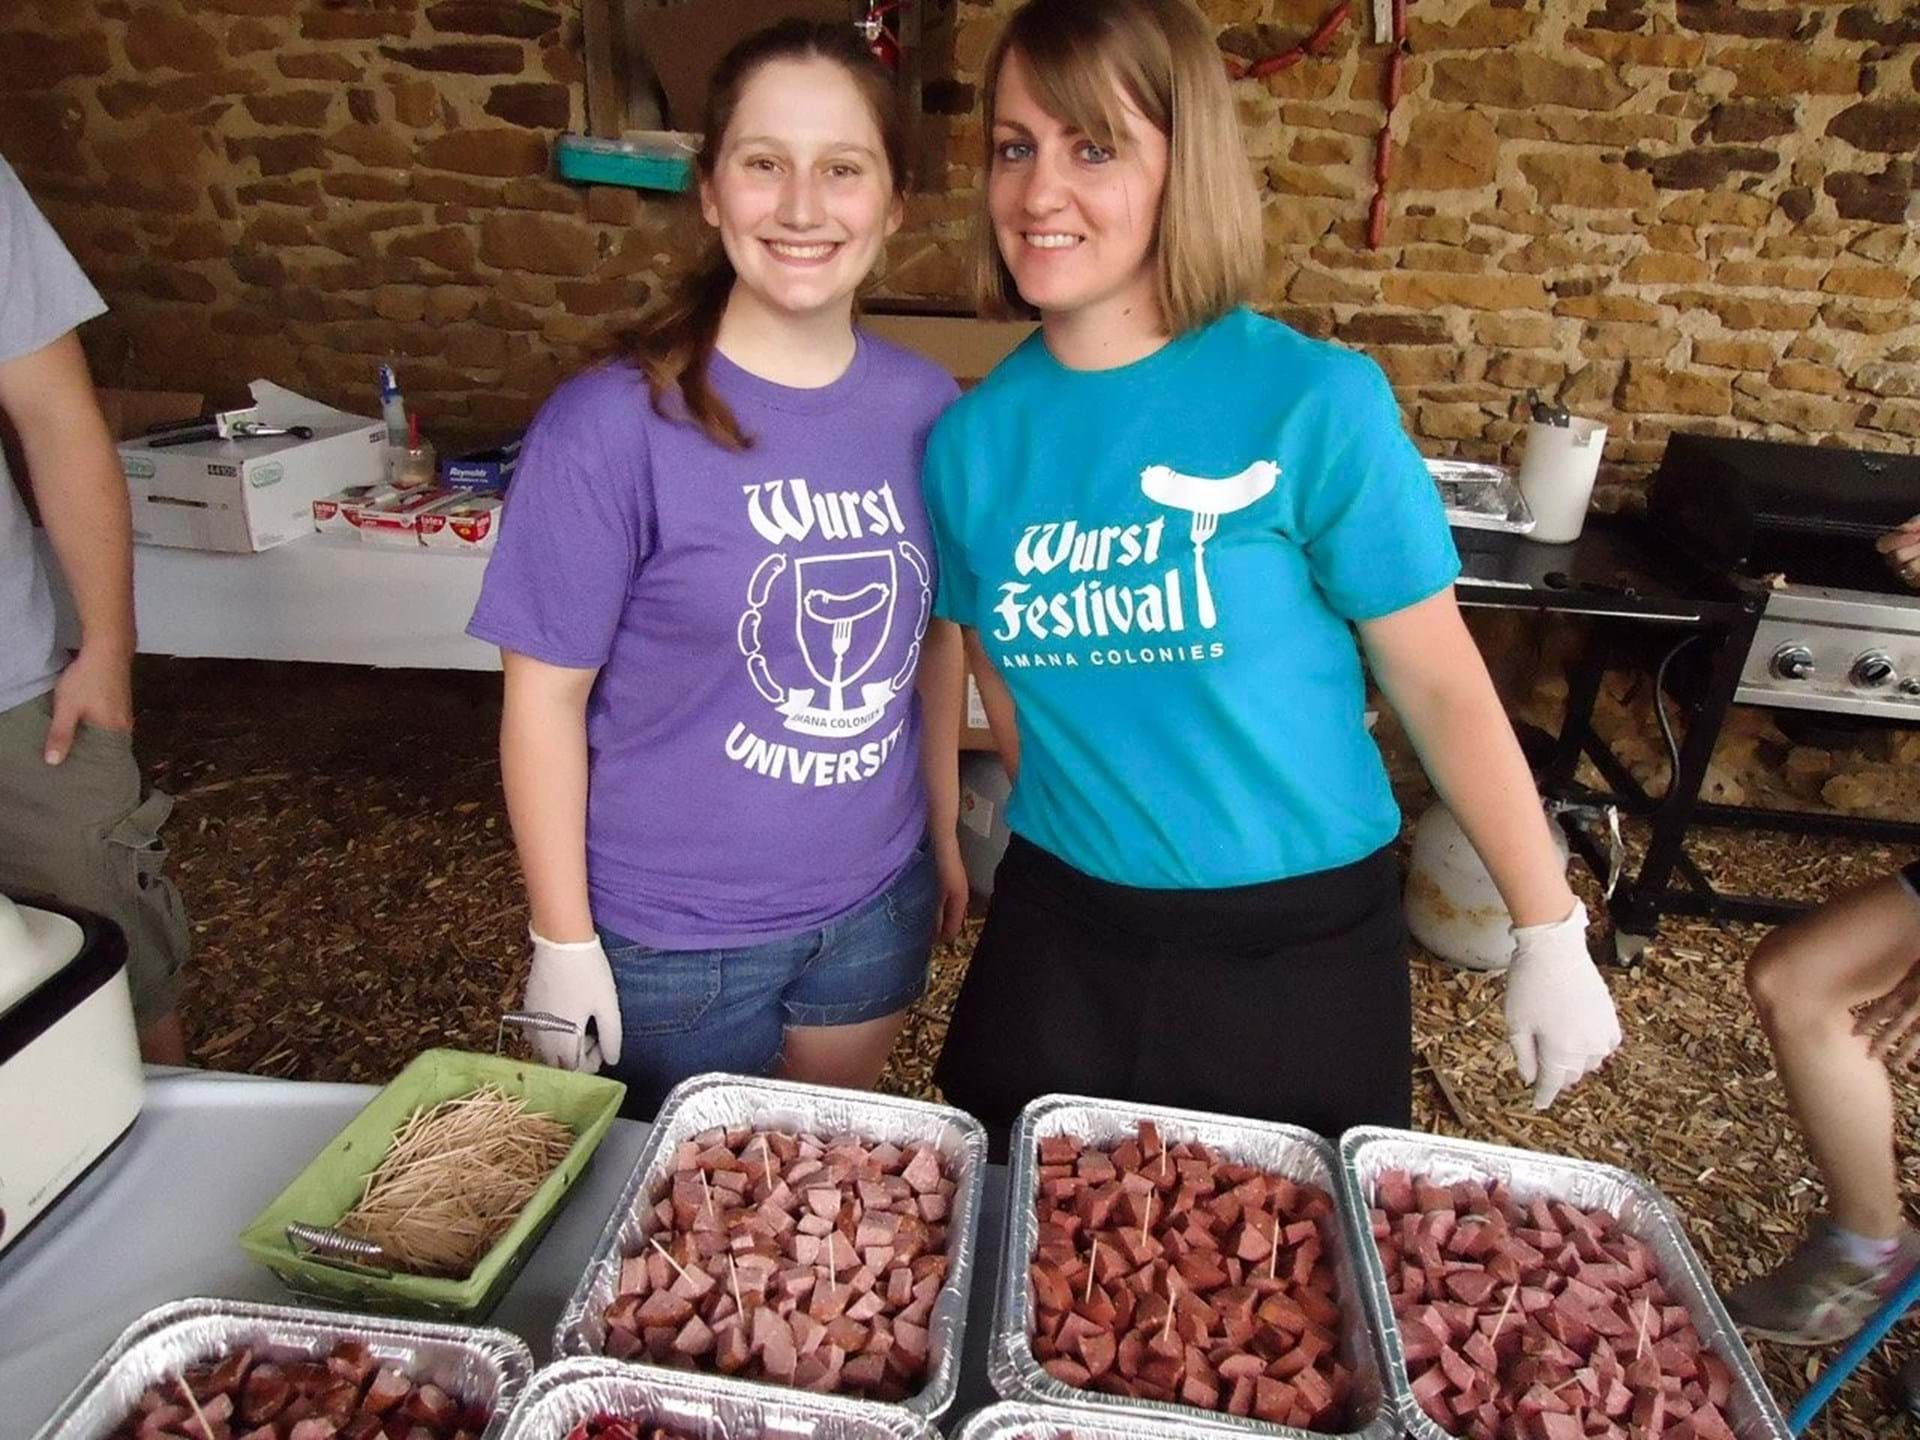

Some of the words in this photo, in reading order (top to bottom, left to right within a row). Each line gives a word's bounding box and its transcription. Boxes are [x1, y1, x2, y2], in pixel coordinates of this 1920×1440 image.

[743, 478, 906, 545] Wurst
[1015, 515, 1165, 576] Wurst
[993, 568, 1185, 641] Festival
[1003, 653, 1078, 668] AMANA
[1091, 643, 1225, 665] COLONIES
